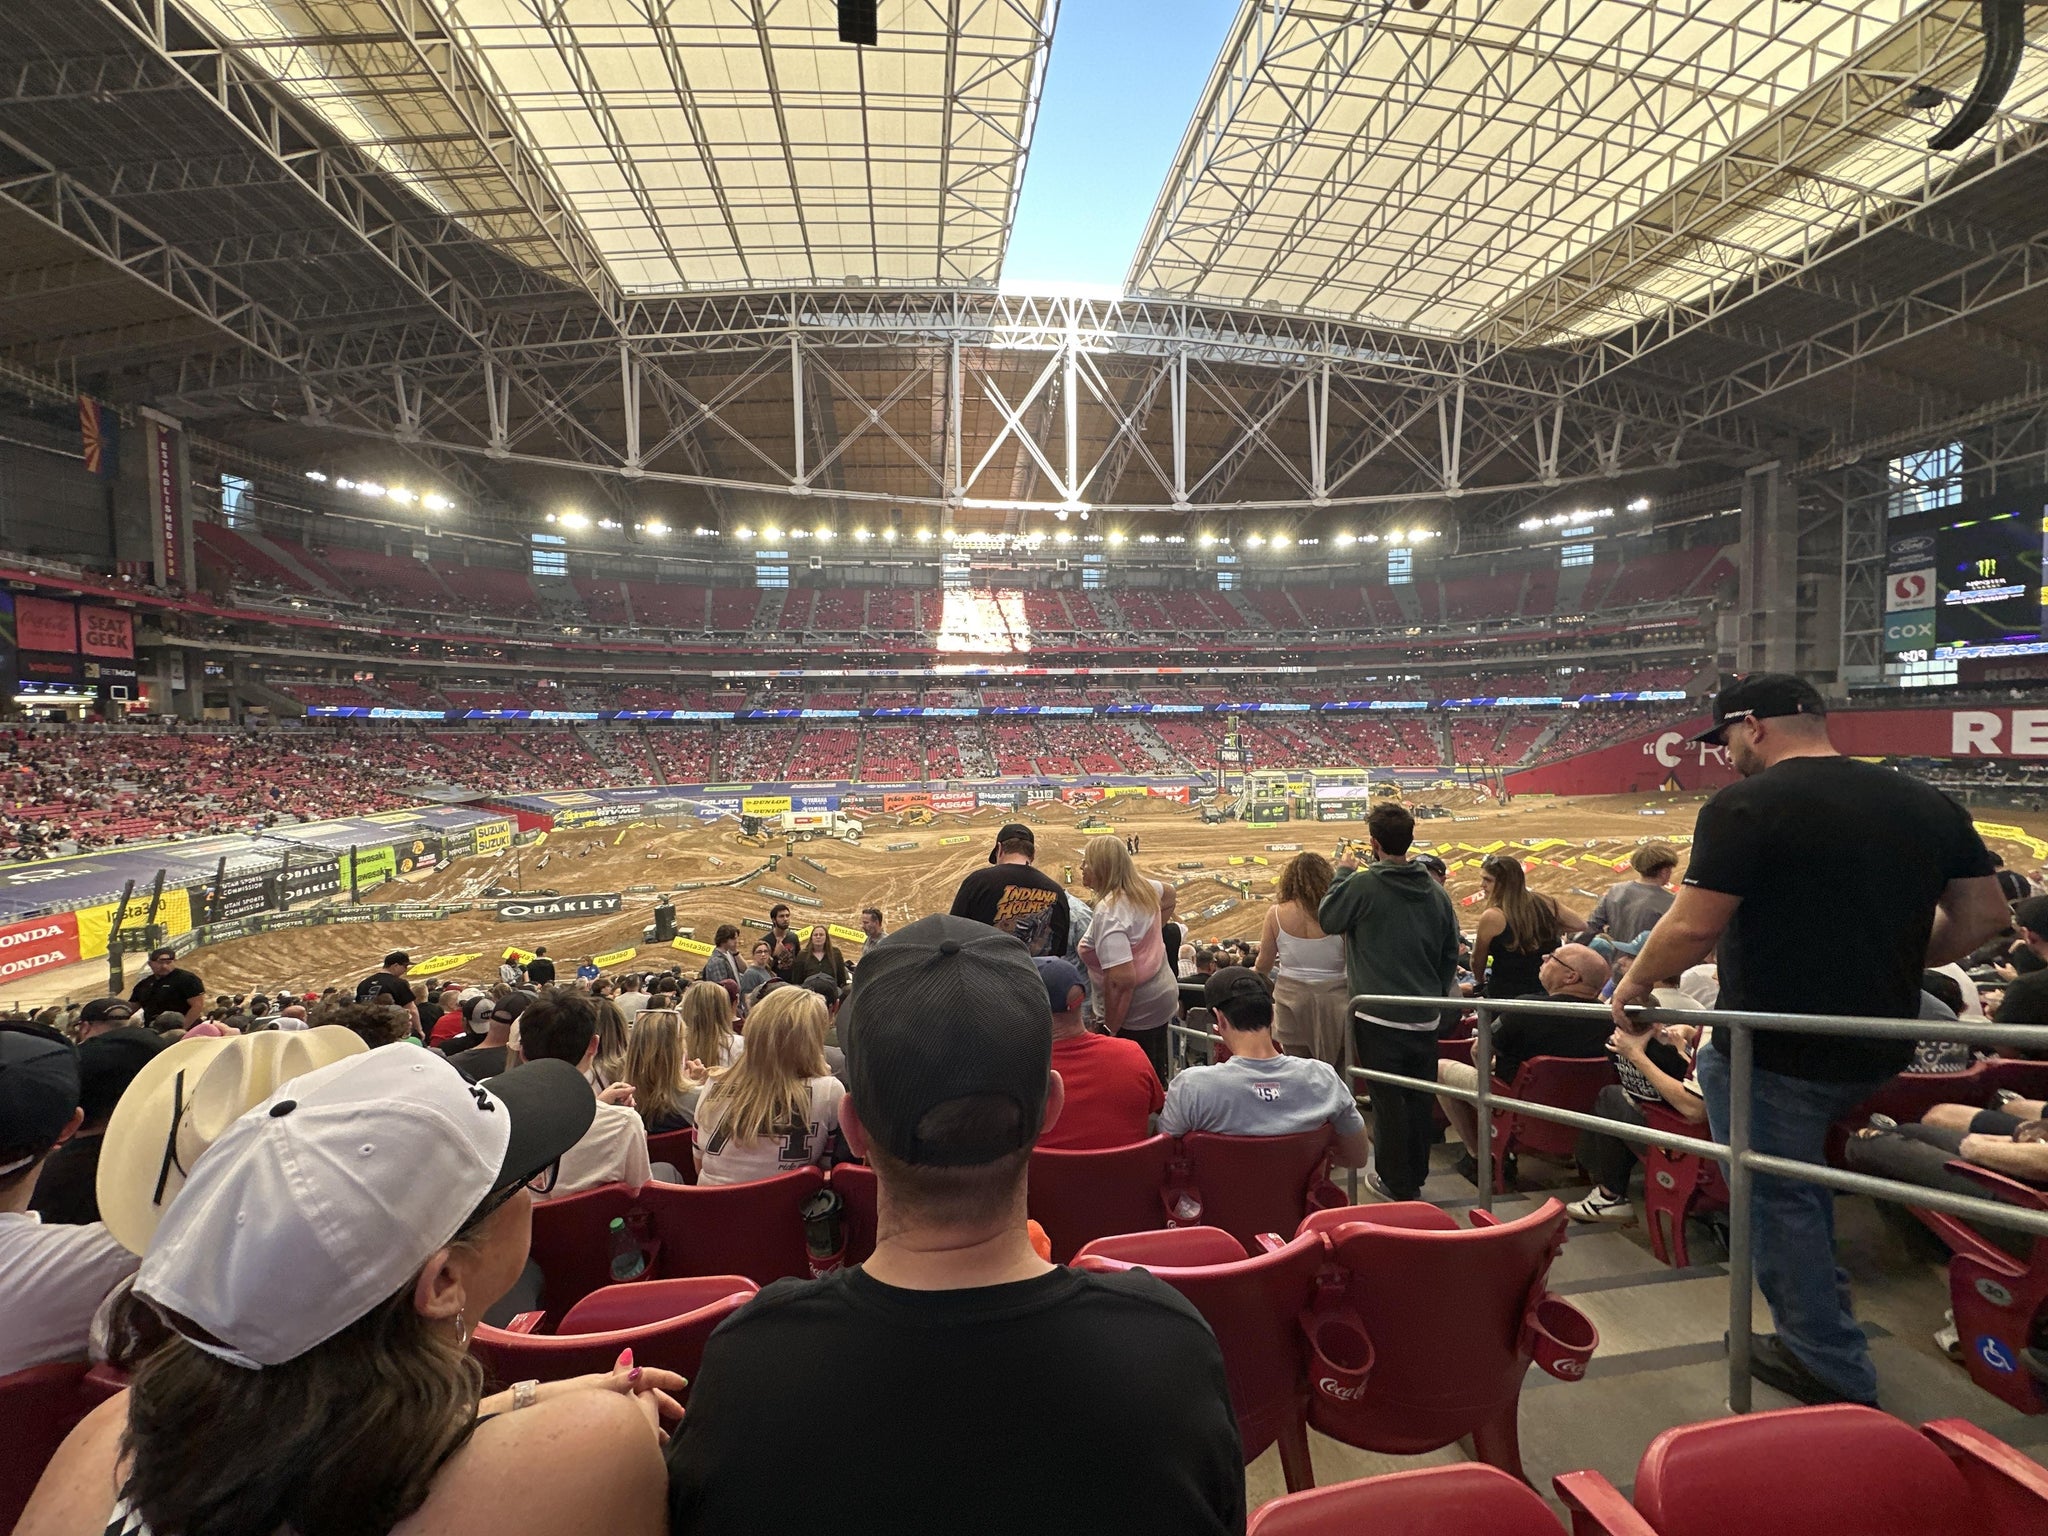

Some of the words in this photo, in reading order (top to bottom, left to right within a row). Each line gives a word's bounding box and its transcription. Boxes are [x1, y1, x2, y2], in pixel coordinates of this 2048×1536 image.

[160, 441, 173, 539] ESTABLISHED
[87, 615, 126, 633] SEAT
[1888, 623, 1933, 639] COX
[85, 631, 129, 650] GEEK
[100, 667, 136, 678] BETMGM
[1952, 709, 2048, 756] RE
[1221, 750, 1240, 761] FINISH
[931, 791, 974, 800] GASGAS
[477, 823, 509, 839] SUZUKI
[478, 835, 510, 851] SUZUKI
[355, 851, 386, 866] awasaki
[294, 863, 340, 878] OAKLEY
[356, 867, 386, 882] awasak
[222, 881, 239, 889] UTAH
[240, 875, 263, 885] SPORTS
[223, 882, 263, 896] COMMISSION
[296, 880, 341, 897] OAKLEY
[1003, 885, 1058, 904] INDIANA
[224, 901, 240, 910] UTAH
[242, 895, 265, 906] SPORTS
[533, 898, 618, 914] OAKLEY
[994, 900, 1053, 921] HOLMES
[834, 926, 865, 939] Insta360
[678, 939, 711, 953] Insta360
[0, 950, 67, 977] ONDA
[424, 957, 459, 970] Insta360
[597, 950, 628, 964] Insta360
